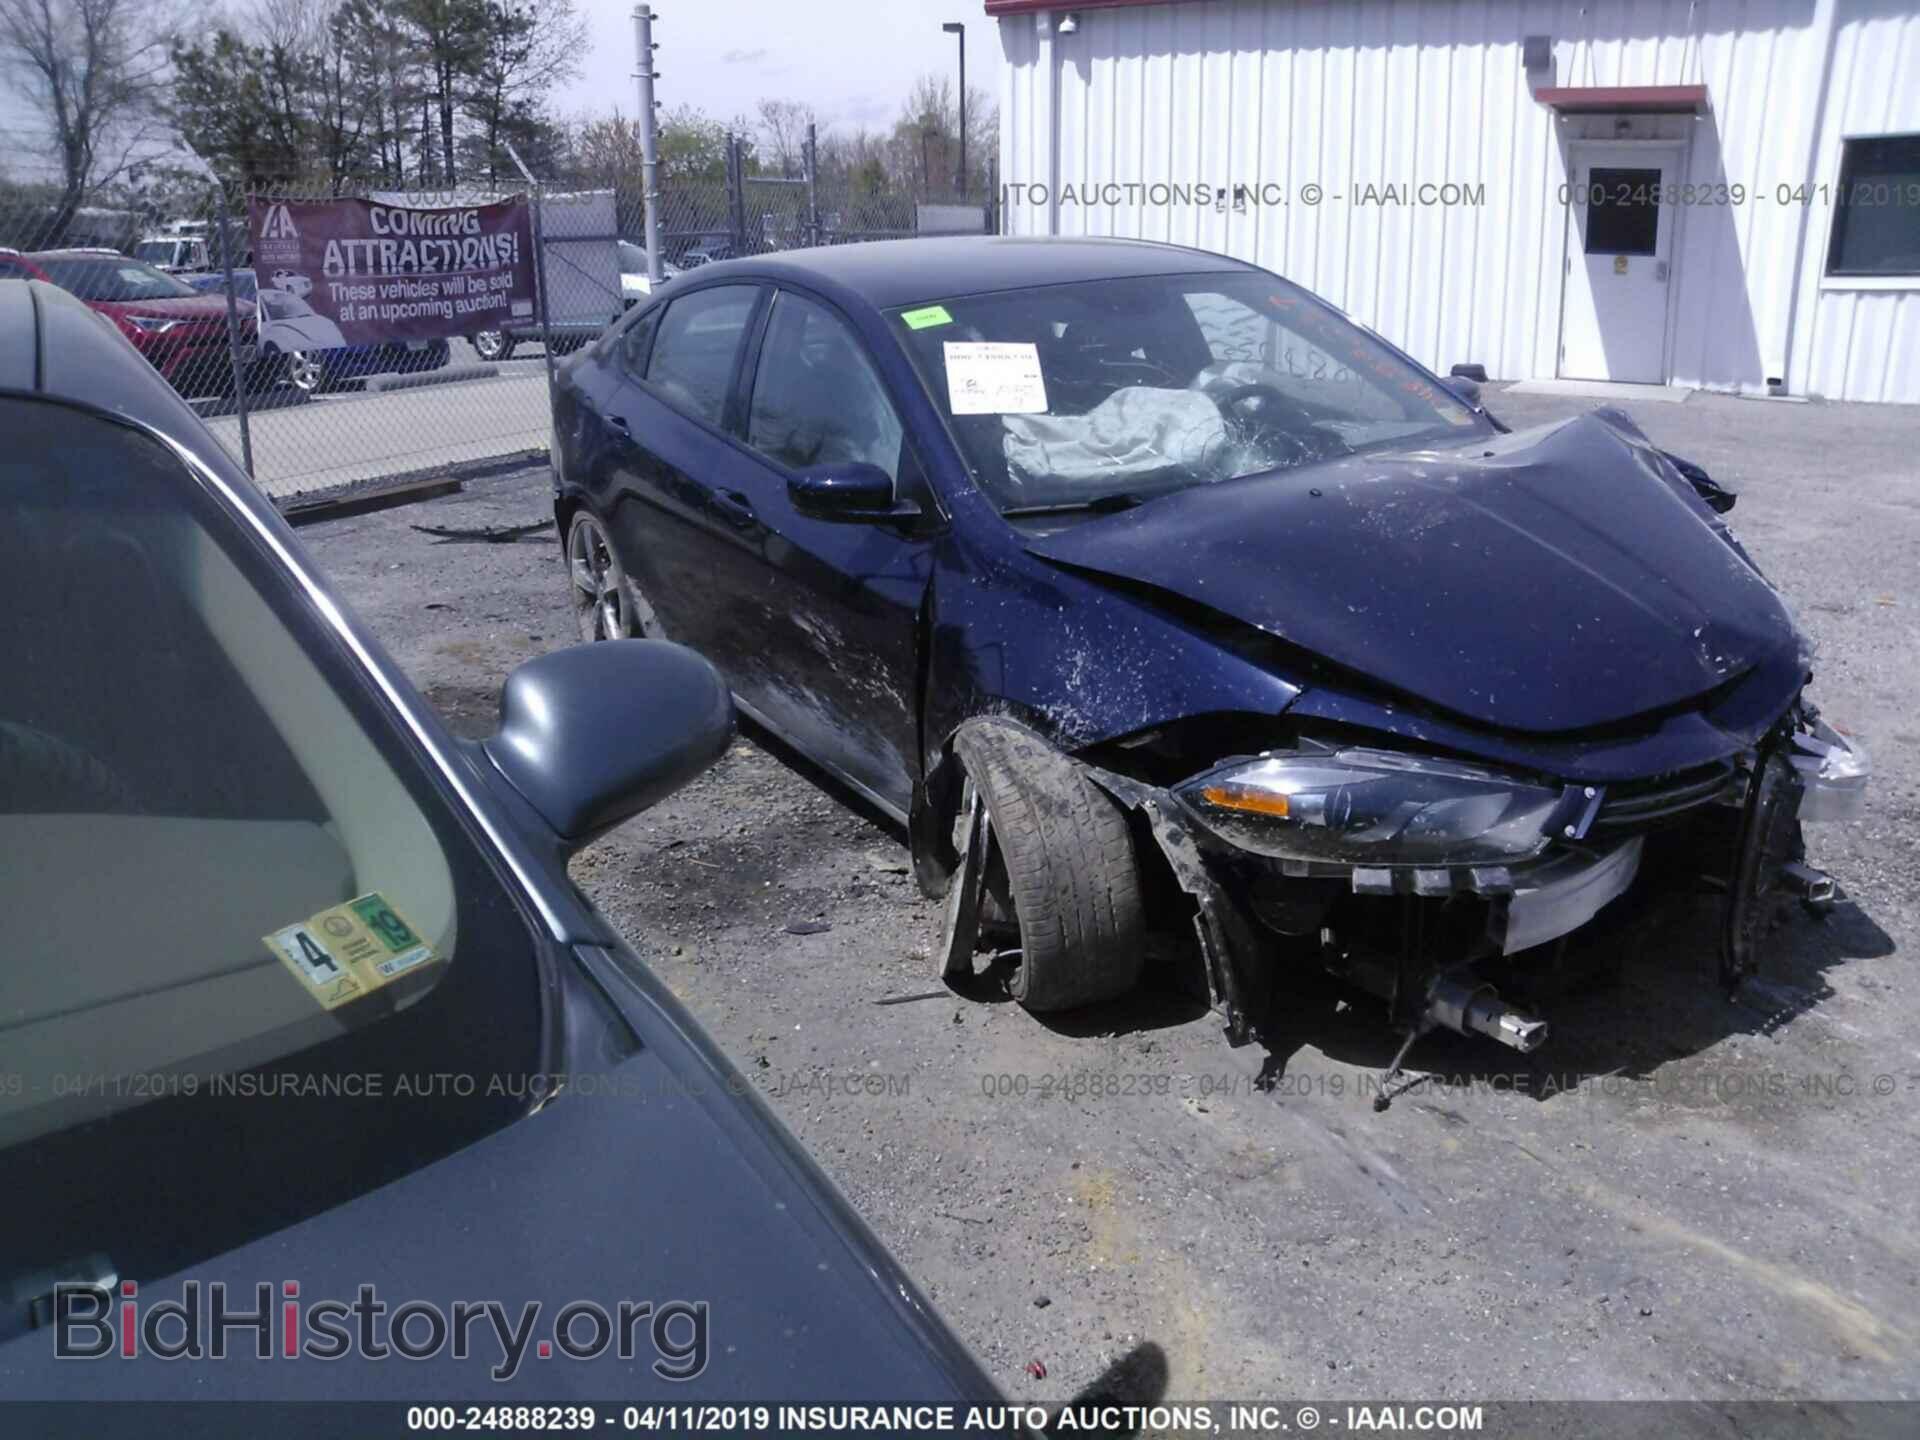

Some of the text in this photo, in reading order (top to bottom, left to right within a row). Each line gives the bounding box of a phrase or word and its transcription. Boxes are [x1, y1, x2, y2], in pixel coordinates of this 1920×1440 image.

[369, 206, 482, 236] COMING
[322, 231, 520, 274] ATTRACTIONS!
[328, 271, 514, 302] These vehicles will be sold
[339, 291, 508, 323] at an upcoming auction!
[295, 931, 339, 972] 4
